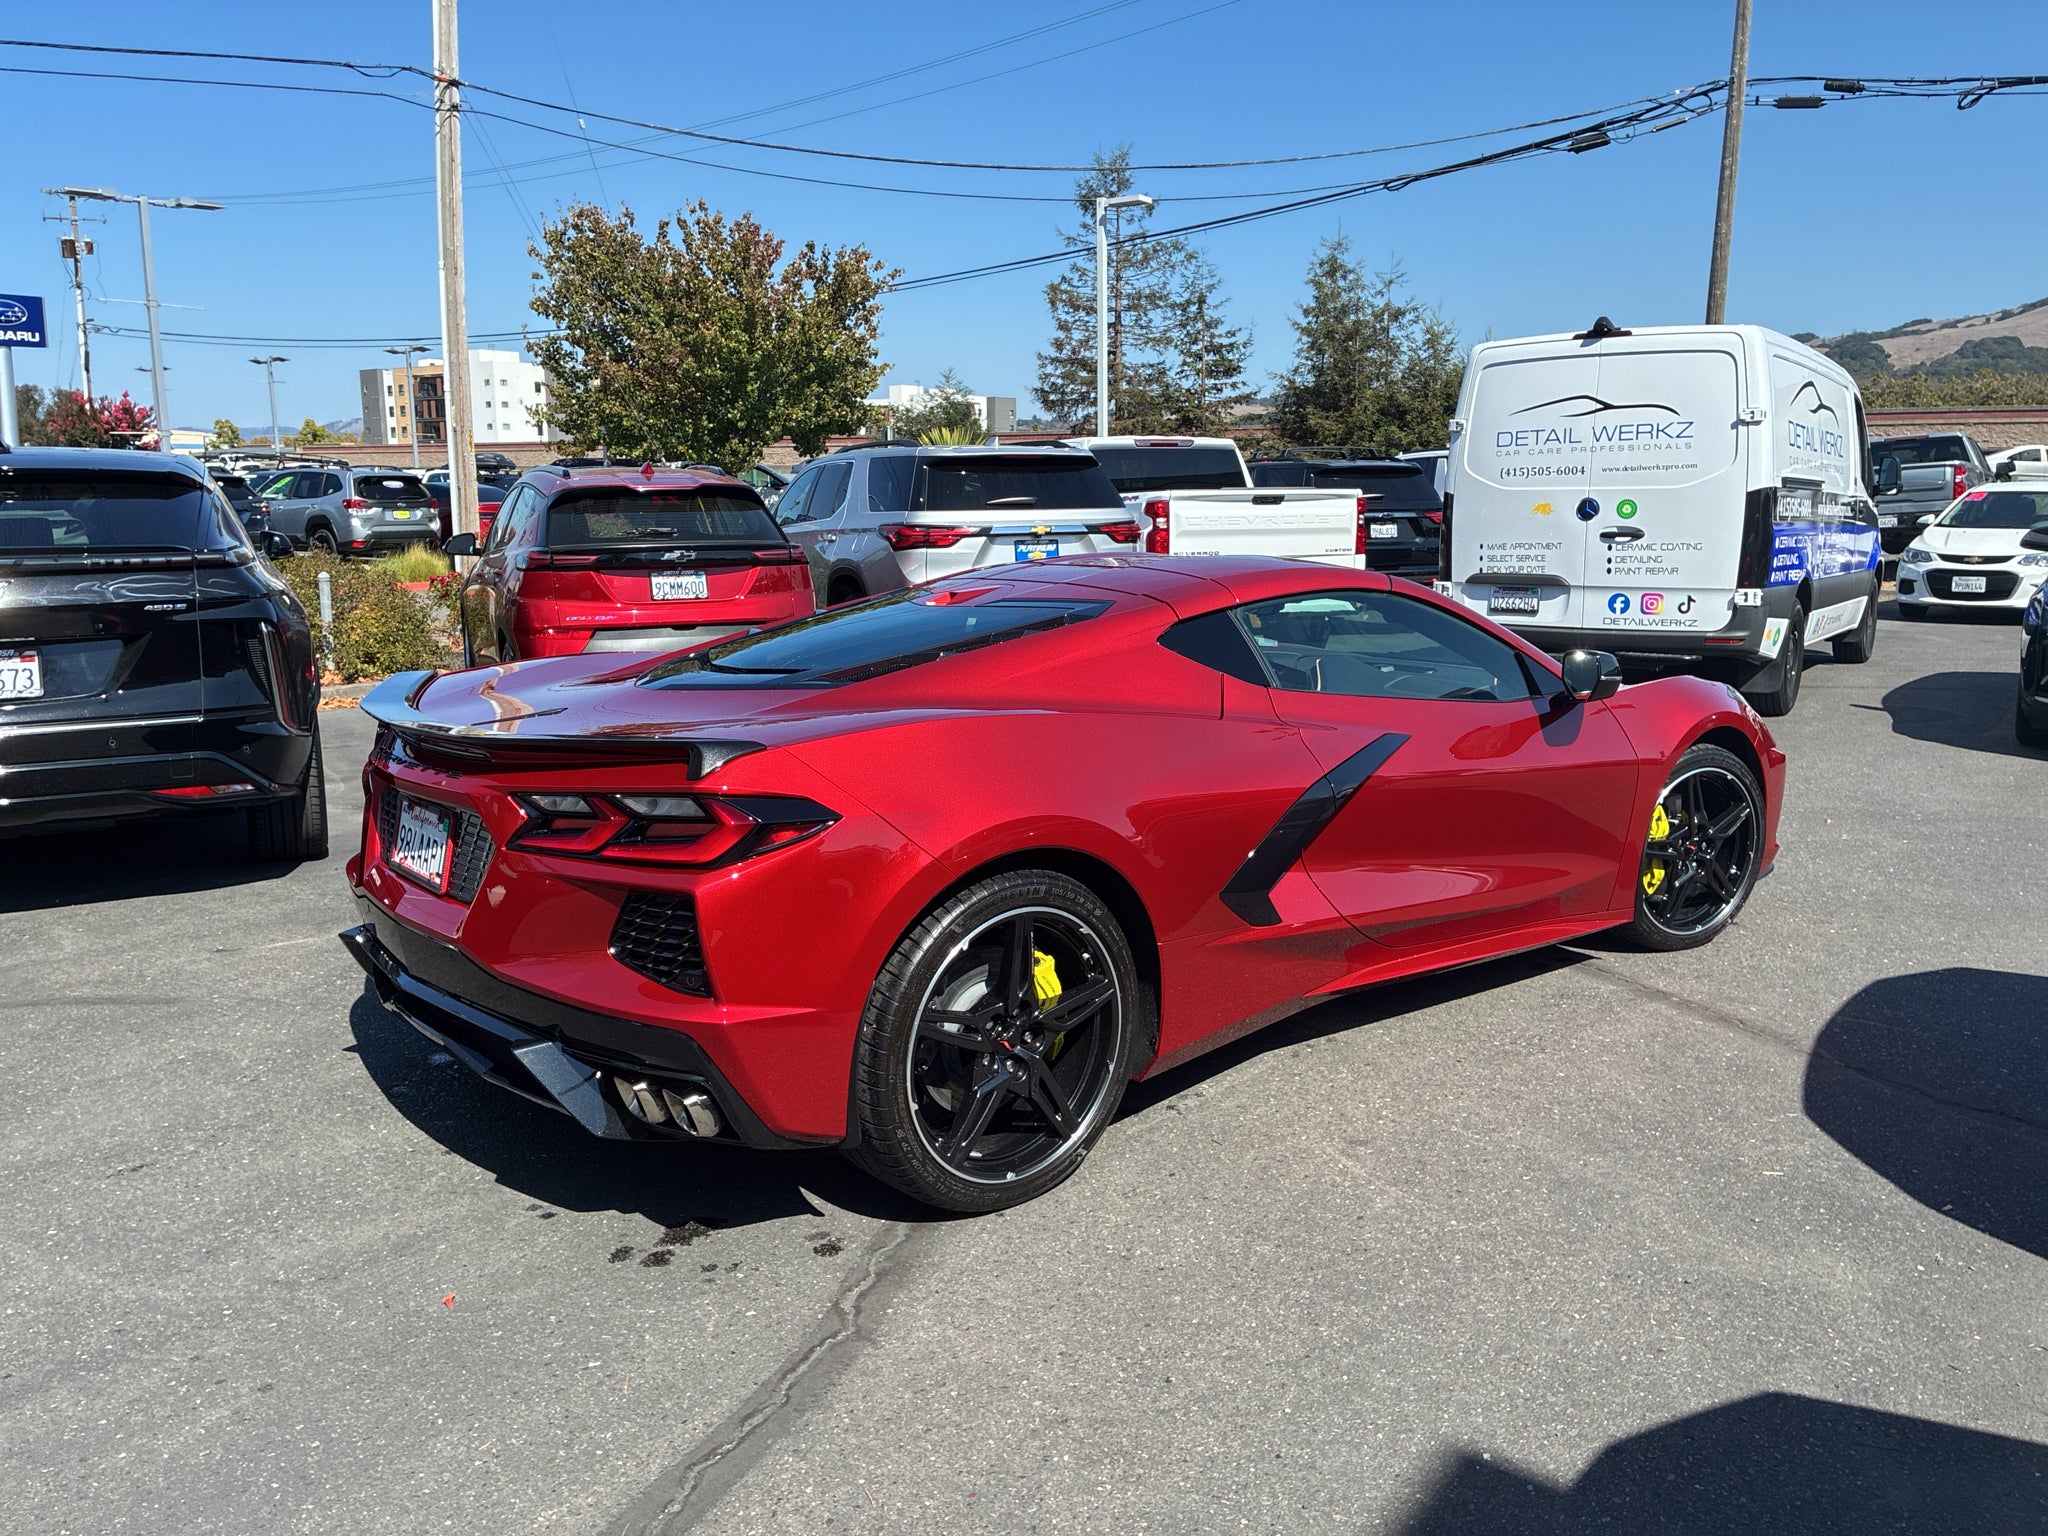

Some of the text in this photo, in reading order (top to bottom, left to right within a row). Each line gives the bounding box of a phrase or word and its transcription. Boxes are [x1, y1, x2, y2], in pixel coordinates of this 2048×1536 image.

[1496, 421, 1694, 448] DETAIL WERKZ
[1788, 420, 1844, 458] DETAIL WERKZ
[1496, 441, 1693, 458] CAR CARE PROFESSIONALS
[1499, 463, 1698, 480] (415)505-6004 www.detailwerkzpro.com
[1184, 513, 1348, 529] CHEVROLET
[1487, 542, 1563, 551] MAKE APPOINTMENT
[1615, 542, 1703, 551] CERAMIC COATING
[1486, 554, 1546, 563] SELECT SERVICE
[1615, 556, 1663, 565] DETAILING
[1615, 567, 1679, 576] PAINT REPAIR
[655, 581, 705, 597] 9CMM600
[1602, 617, 1698, 627] DETAILWERKZ
[397, 824, 446, 875] 984AAP1
[1050, 887, 1075, 900] 305/30
